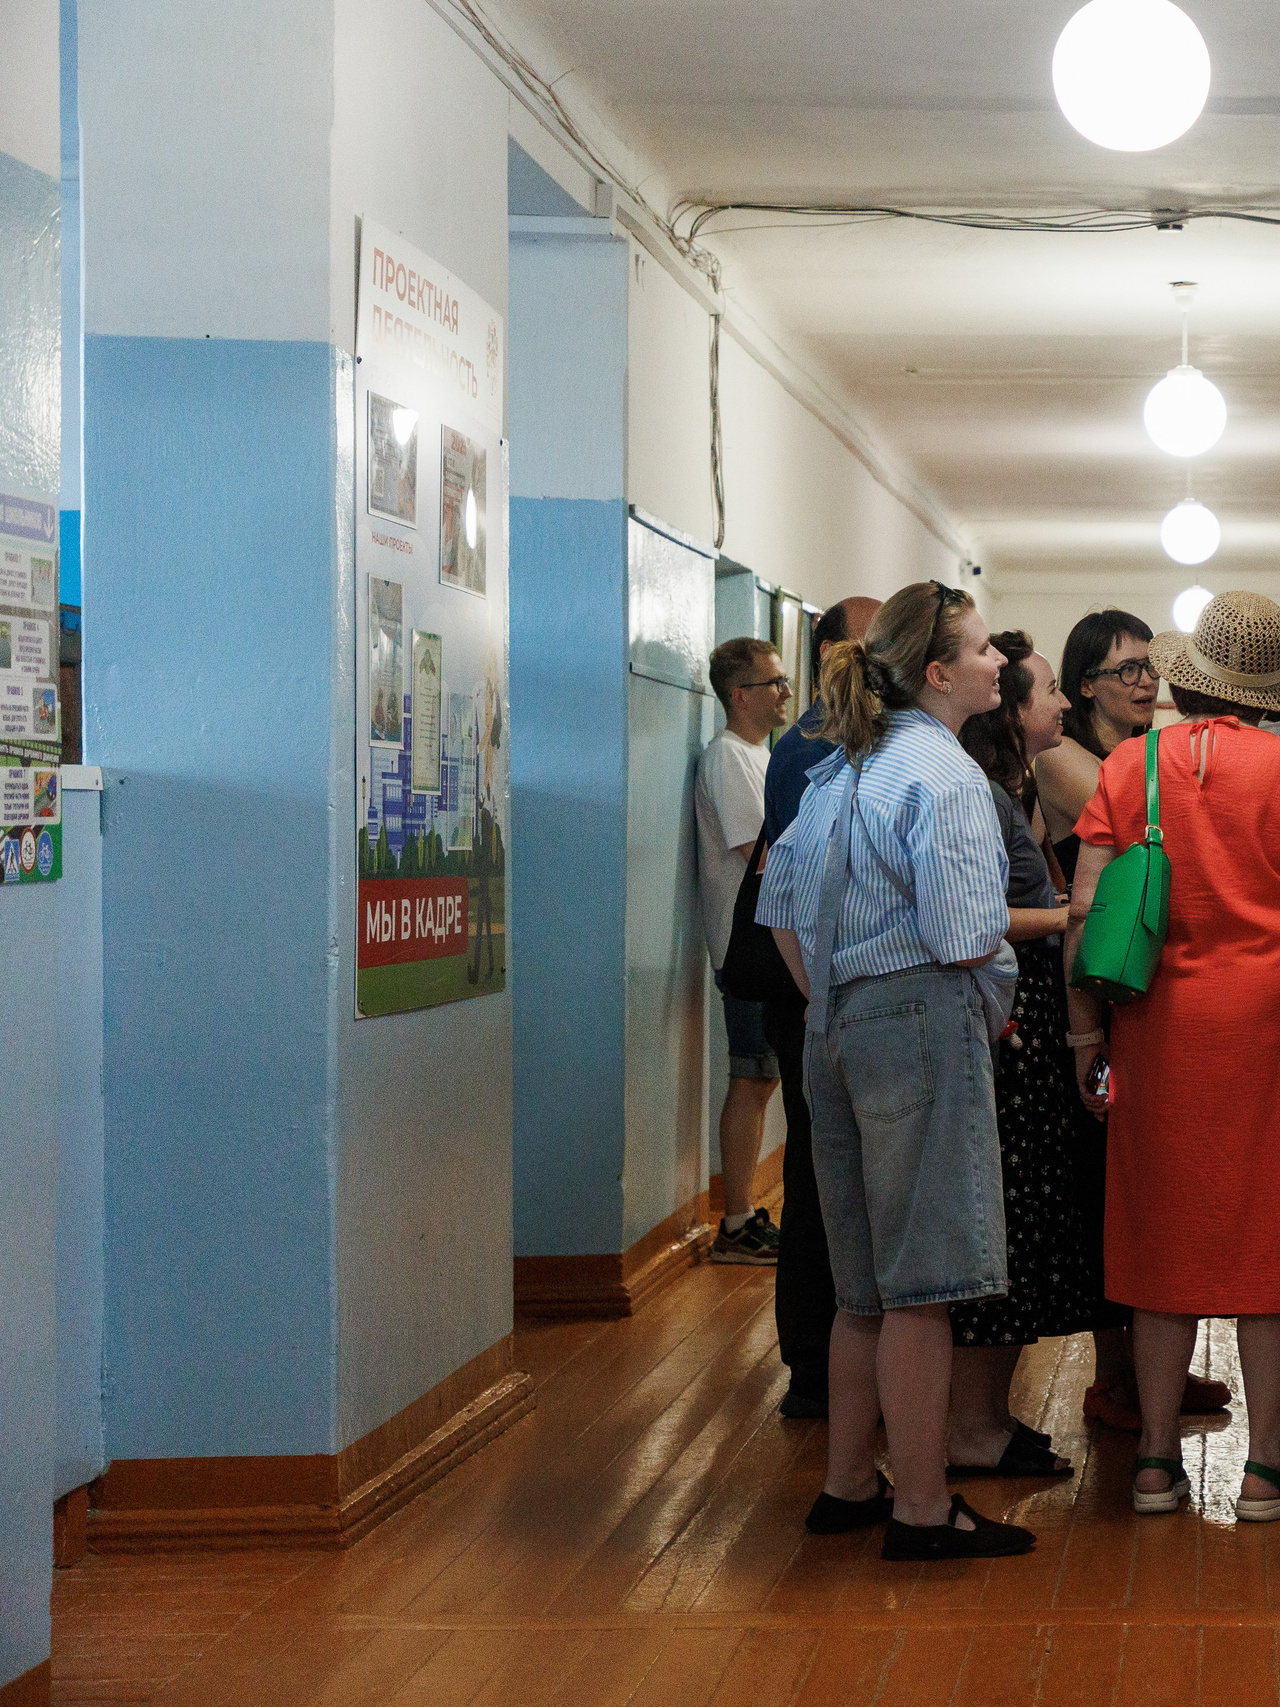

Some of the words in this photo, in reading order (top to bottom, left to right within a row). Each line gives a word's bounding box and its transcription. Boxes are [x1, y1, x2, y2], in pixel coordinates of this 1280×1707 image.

[372, 247, 459, 336] ПРОЕКТНАЯ
[371, 531, 388, 546] НАШИ
[389, 536, 414, 555] ПРОЕКТЫ
[366, 900, 396, 944] МЫ
[401, 898, 411, 940] В
[415, 895, 462, 944] КАДРЕ
